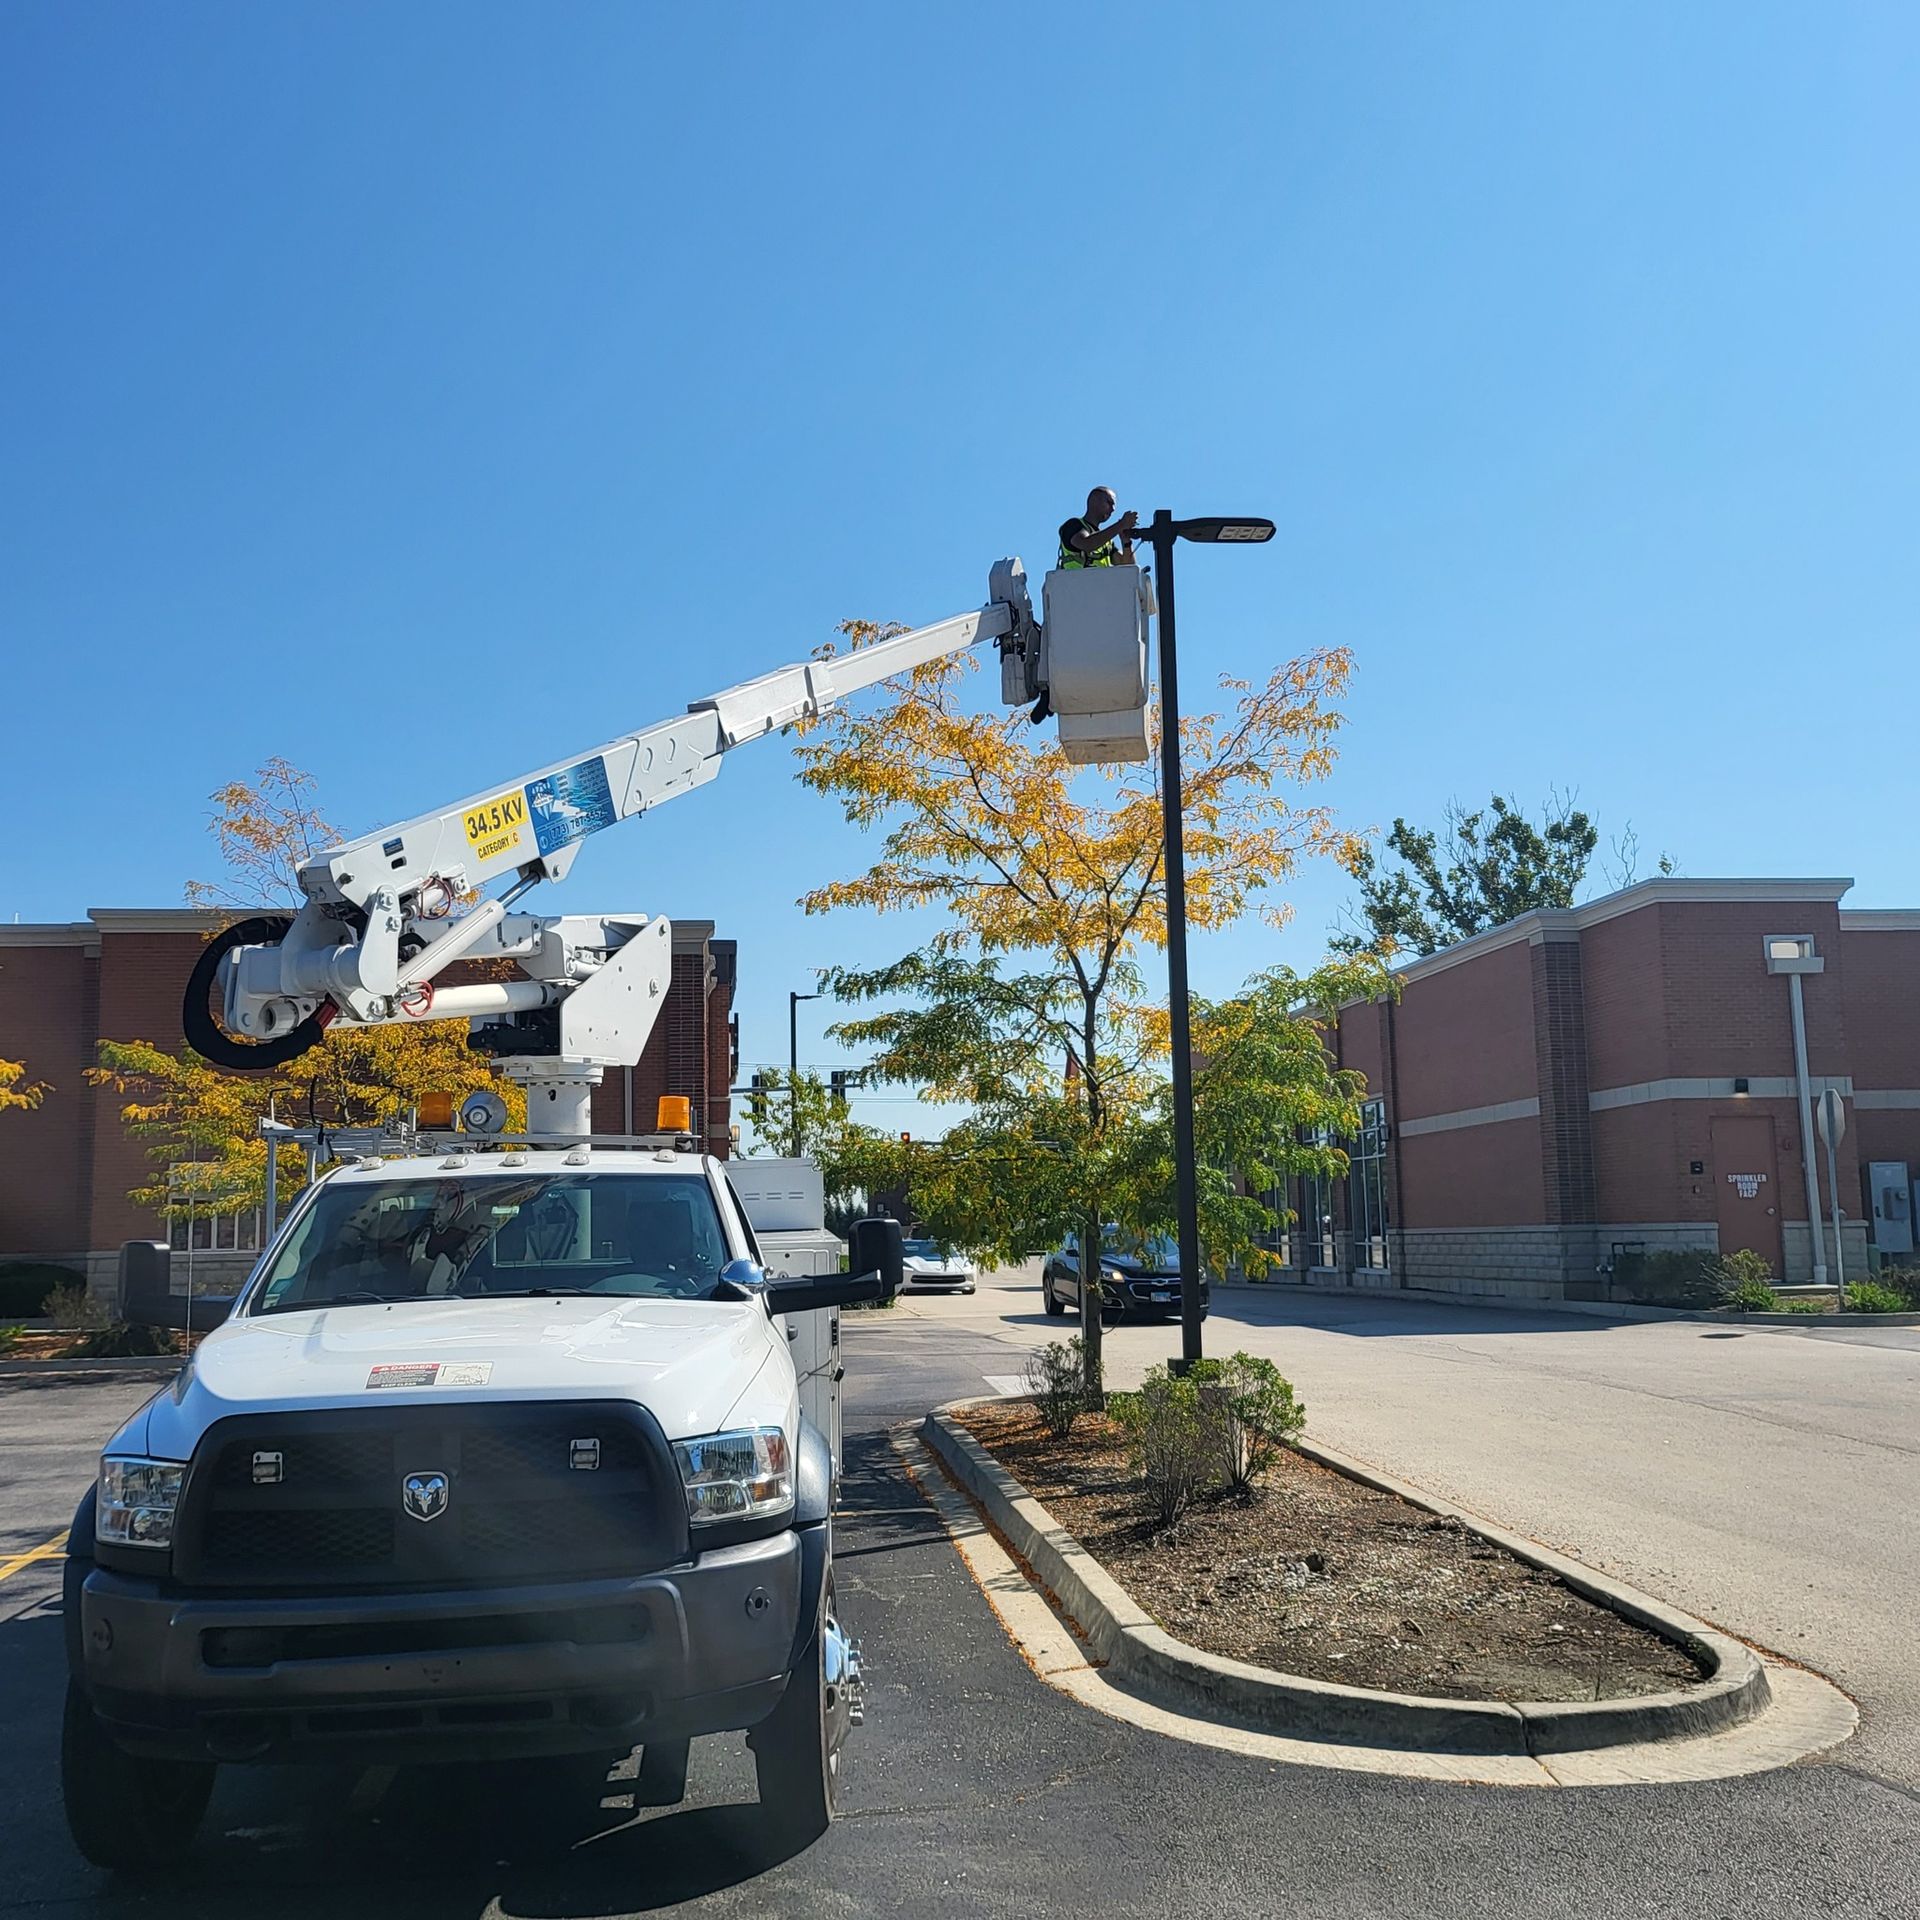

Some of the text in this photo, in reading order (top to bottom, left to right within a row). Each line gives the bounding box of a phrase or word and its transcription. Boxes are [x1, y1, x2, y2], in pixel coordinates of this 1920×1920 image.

[467, 797, 523, 839] 34.5 KV
[550, 822, 570, 841] (773)
[478, 832, 519, 859] CATEGORY C
[1727, 1174, 1767, 1183] SPRINKLER
[1737, 1182, 1758, 1190] ROOM
[1739, 1190, 1757, 1198] FACP
